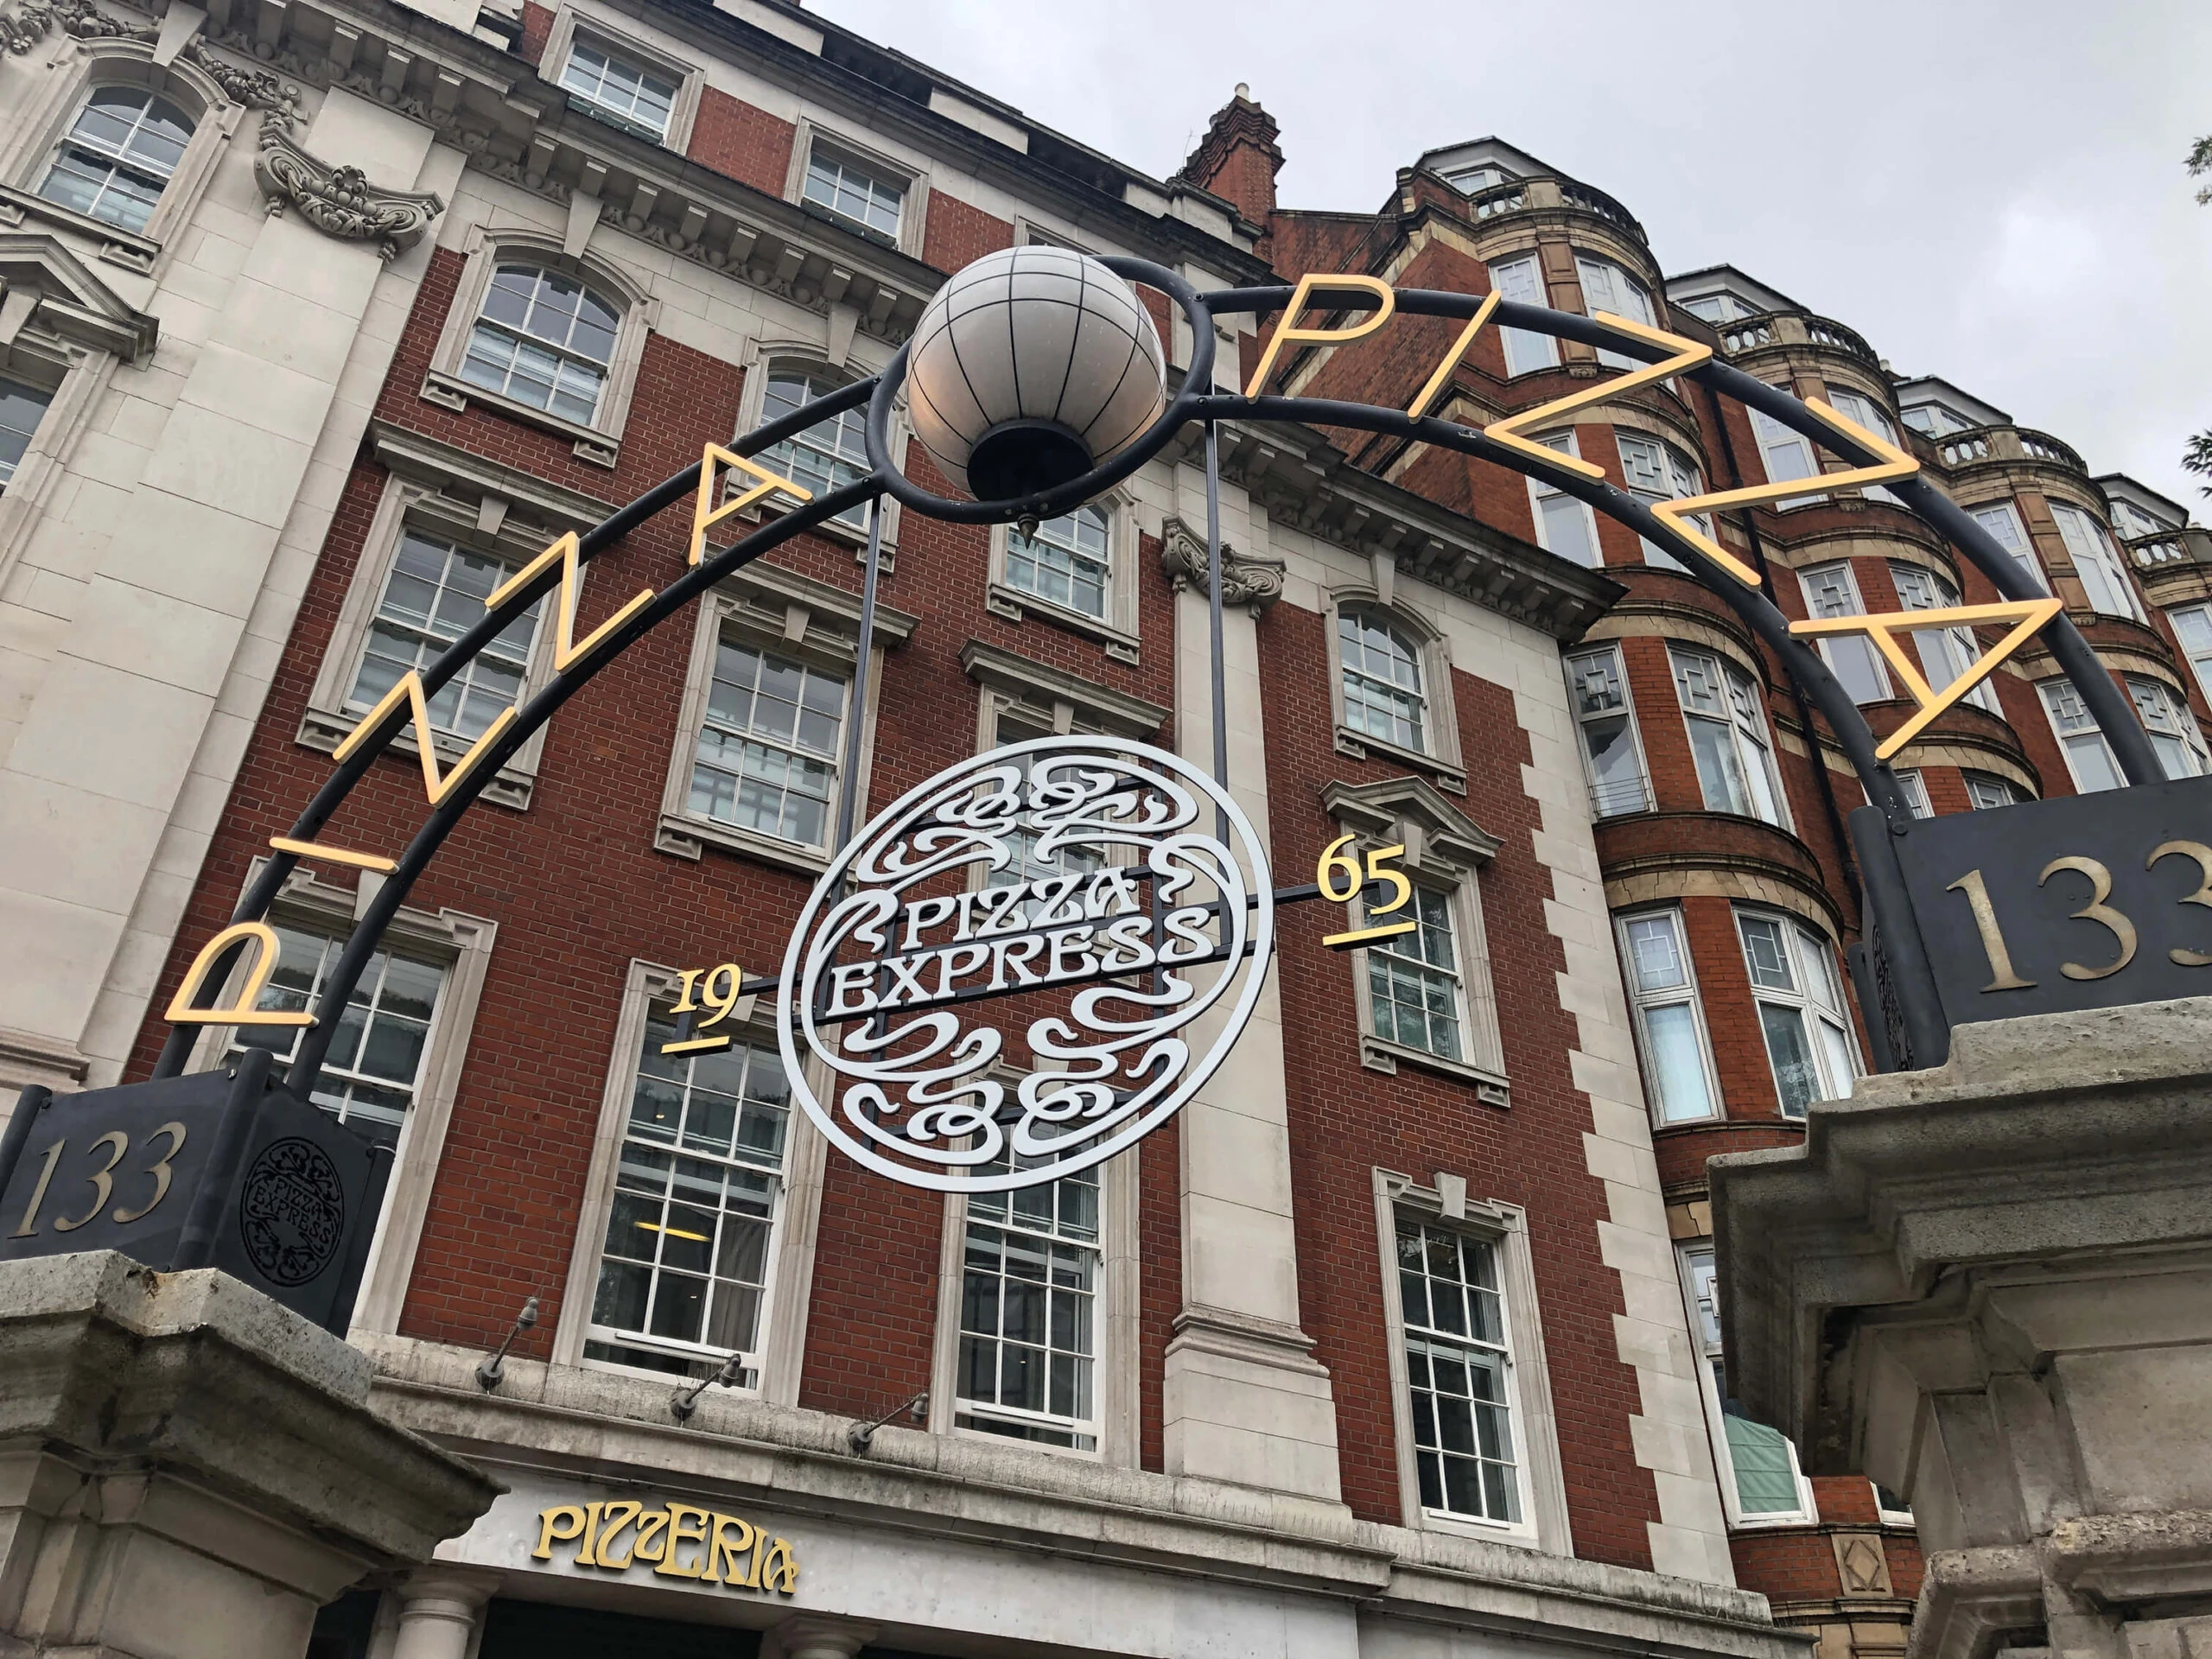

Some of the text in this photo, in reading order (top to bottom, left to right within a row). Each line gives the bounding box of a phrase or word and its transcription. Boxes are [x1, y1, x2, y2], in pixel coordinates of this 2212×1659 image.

[1246, 272, 2064, 763] PIZZA
[165, 442, 816, 1027] PIZZA
[900, 868, 1141, 952] PIZZA
[1317, 833, 1413, 915] 65
[669, 963, 742, 1027] 19
[826, 906, 1215, 1019] EXPRESS
[7, 1122, 187, 1239] 133
[253, 1185, 332, 1244] EXPRESS
[274, 1178, 323, 1220] PIZZA
[531, 1501, 800, 1594] PIZZERIA
